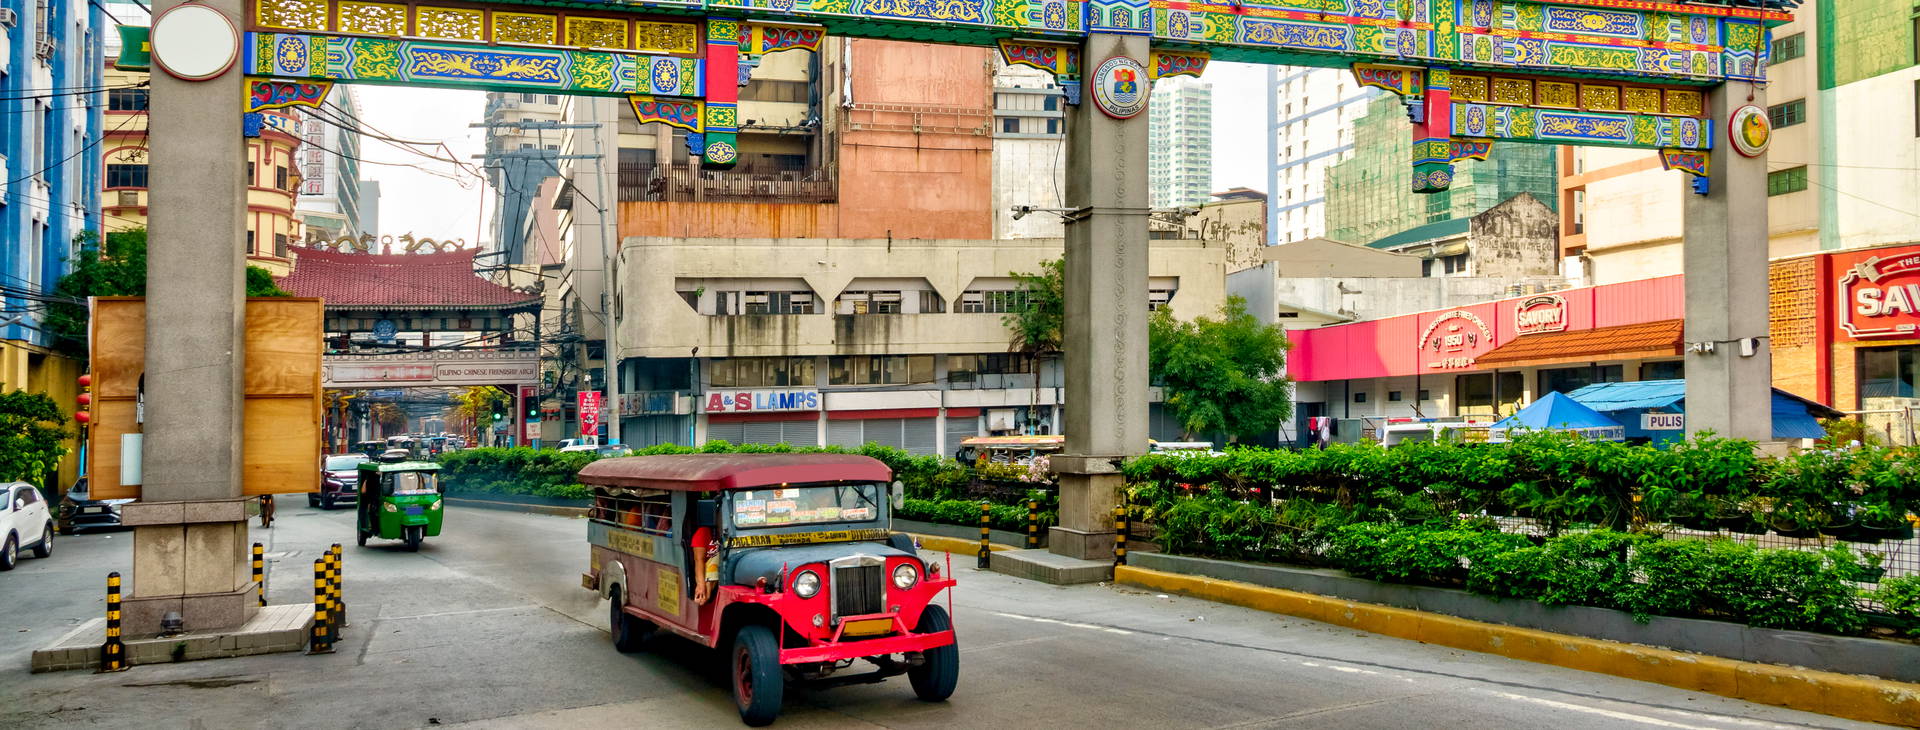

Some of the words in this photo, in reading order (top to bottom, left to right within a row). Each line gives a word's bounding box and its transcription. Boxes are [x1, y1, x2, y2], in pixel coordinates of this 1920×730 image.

[1109, 105, 1139, 114] PILIPINAS
[1519, 308, 1560, 327] SAVORY
[1445, 334, 1464, 347] 1950
[756, 391, 817, 409] LAMPS
[1651, 416, 1683, 427] PULIS
[851, 528, 888, 540] DIVISORIA
